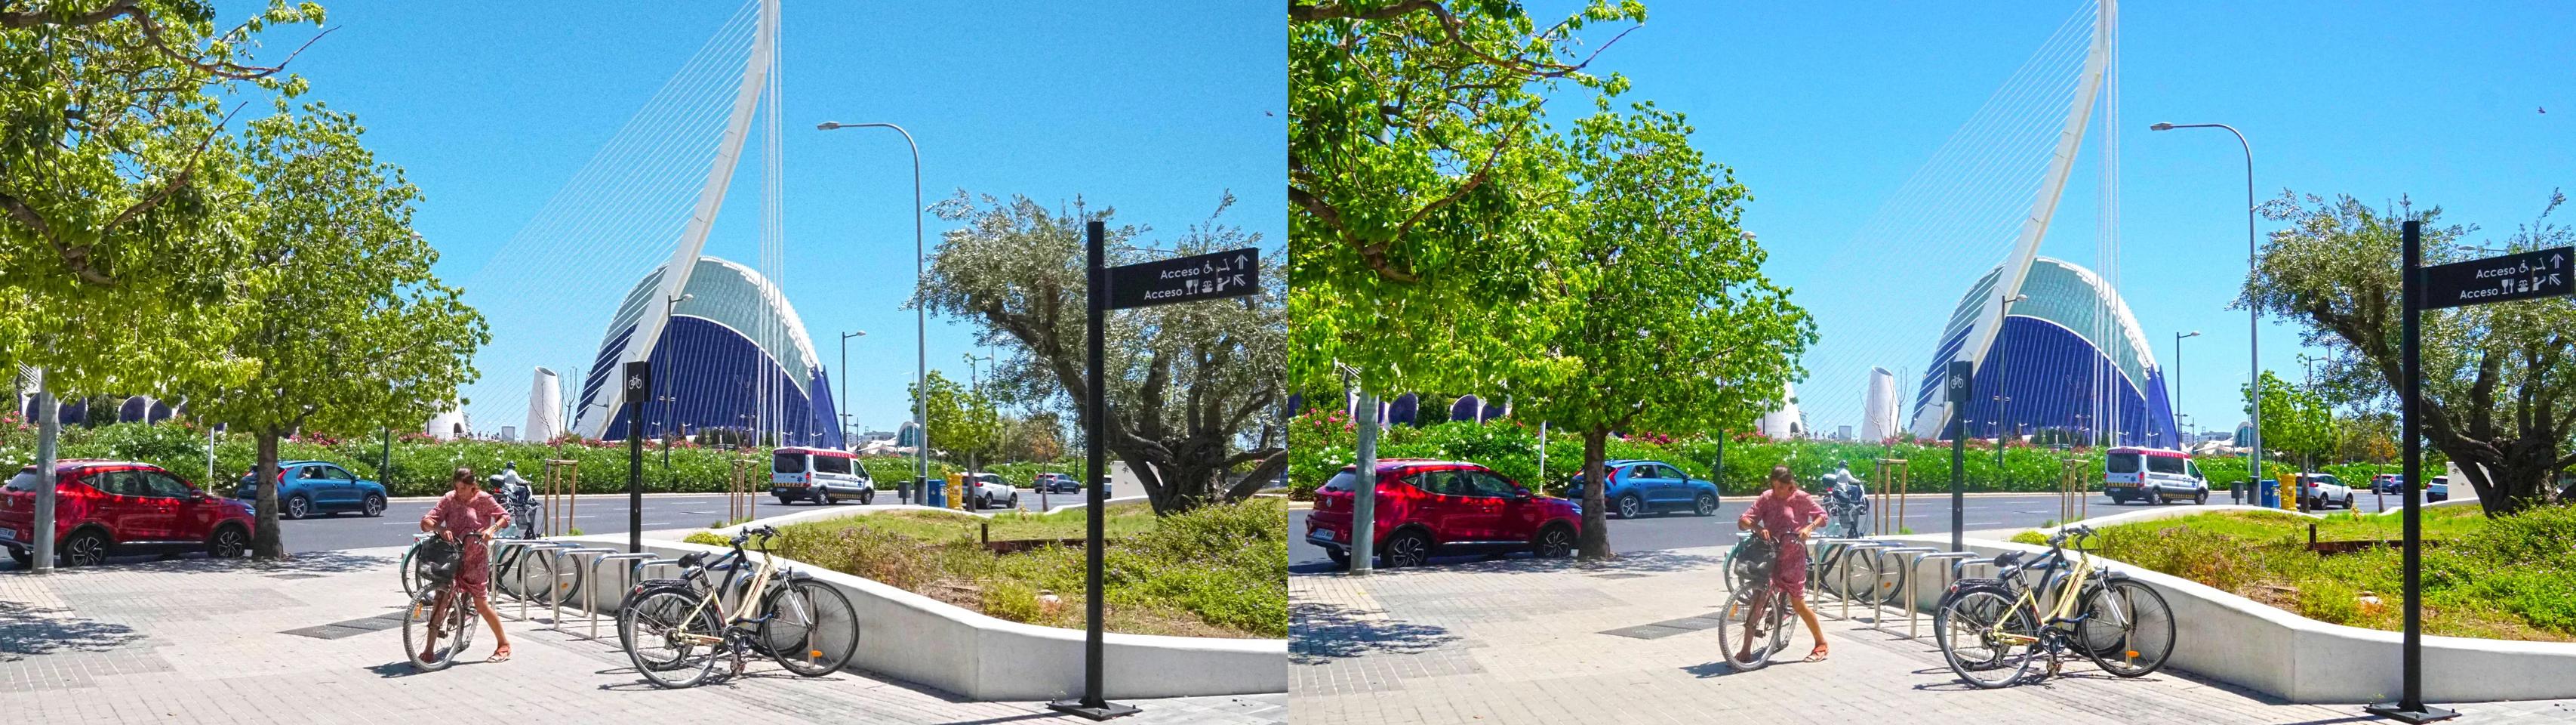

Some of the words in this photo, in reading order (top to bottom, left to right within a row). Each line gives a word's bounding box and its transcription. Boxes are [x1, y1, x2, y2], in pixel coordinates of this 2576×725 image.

[1160, 267, 1200, 279] Acceso
[2476, 268, 2516, 279] Acceso
[1143, 288, 1183, 301] Acceso
[2460, 288, 2498, 300] Acceso
